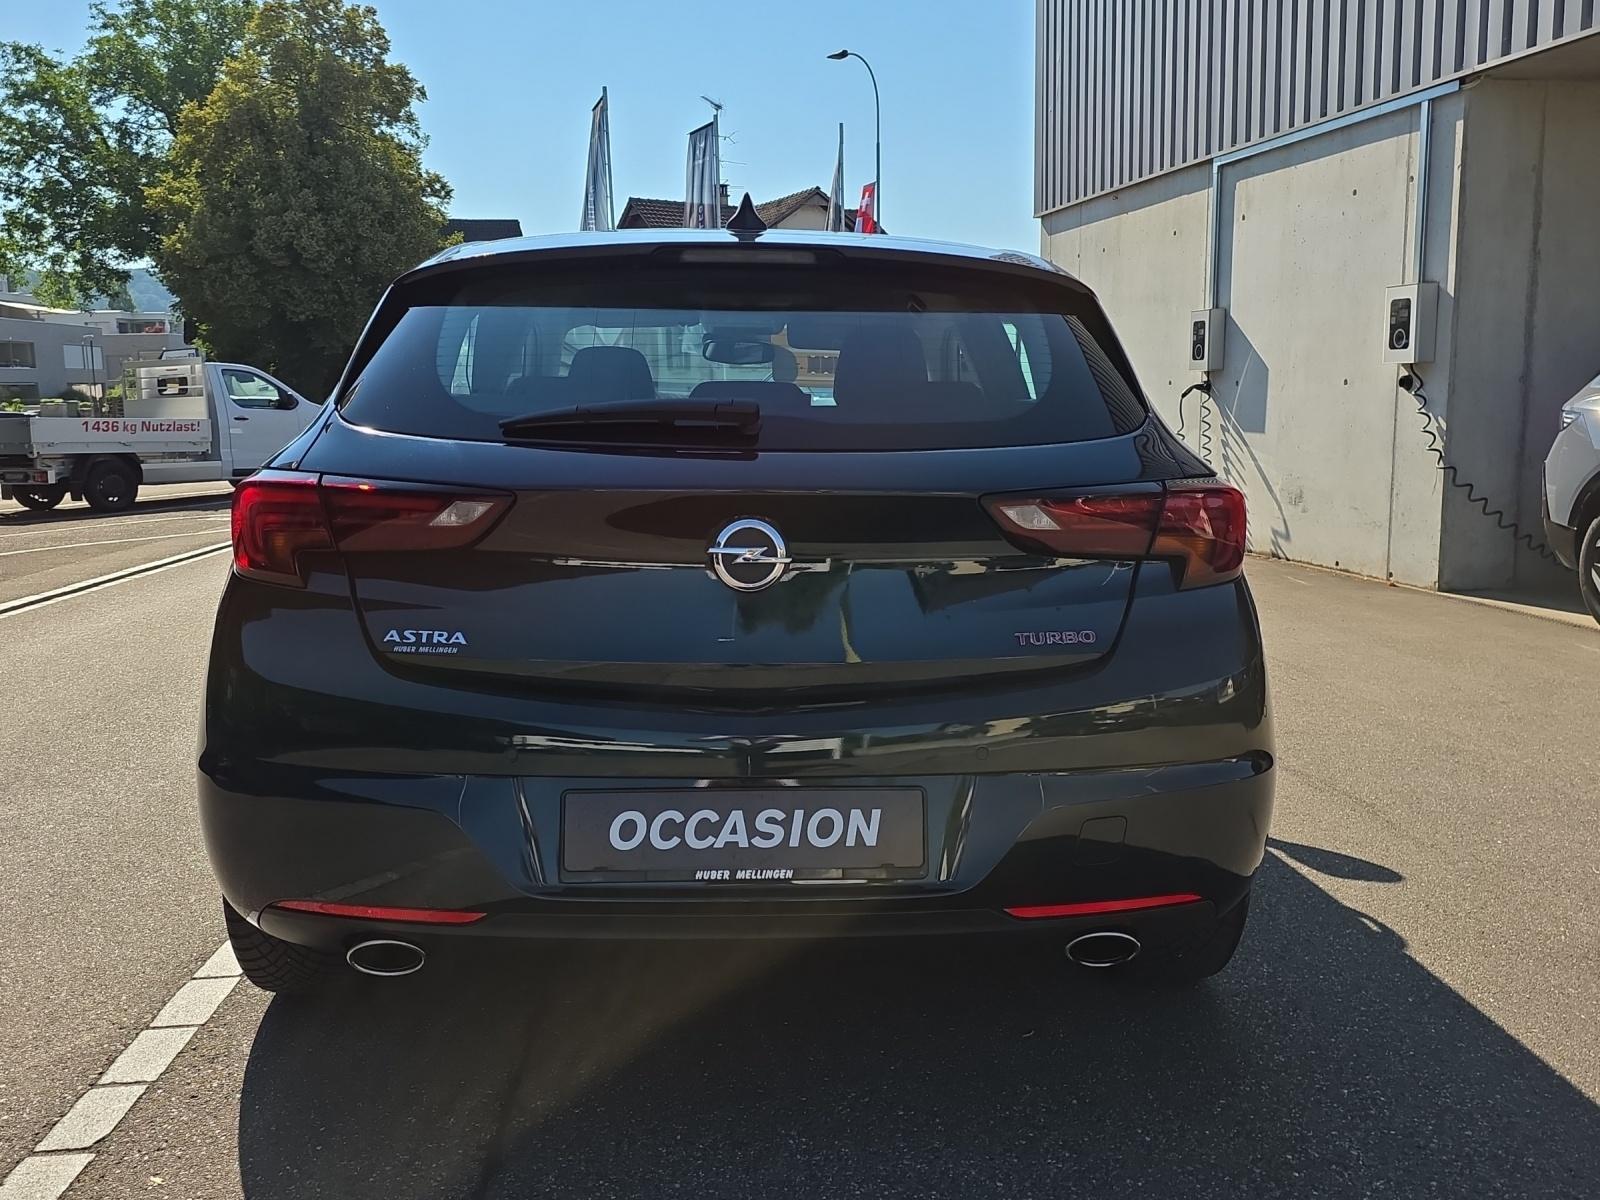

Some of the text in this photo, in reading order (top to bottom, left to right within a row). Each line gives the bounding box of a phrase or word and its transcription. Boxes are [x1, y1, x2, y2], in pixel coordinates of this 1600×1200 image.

[82, 421, 200, 434] 1436 kg Nutzlast!
[384, 629, 467, 645] ASTRA
[1015, 630, 1096, 646] TURBO
[418, 646, 458, 654] MELLINGEN
[608, 808, 882, 851] OCCASION
[695, 869, 794, 880] HUBER MELLINGEN
